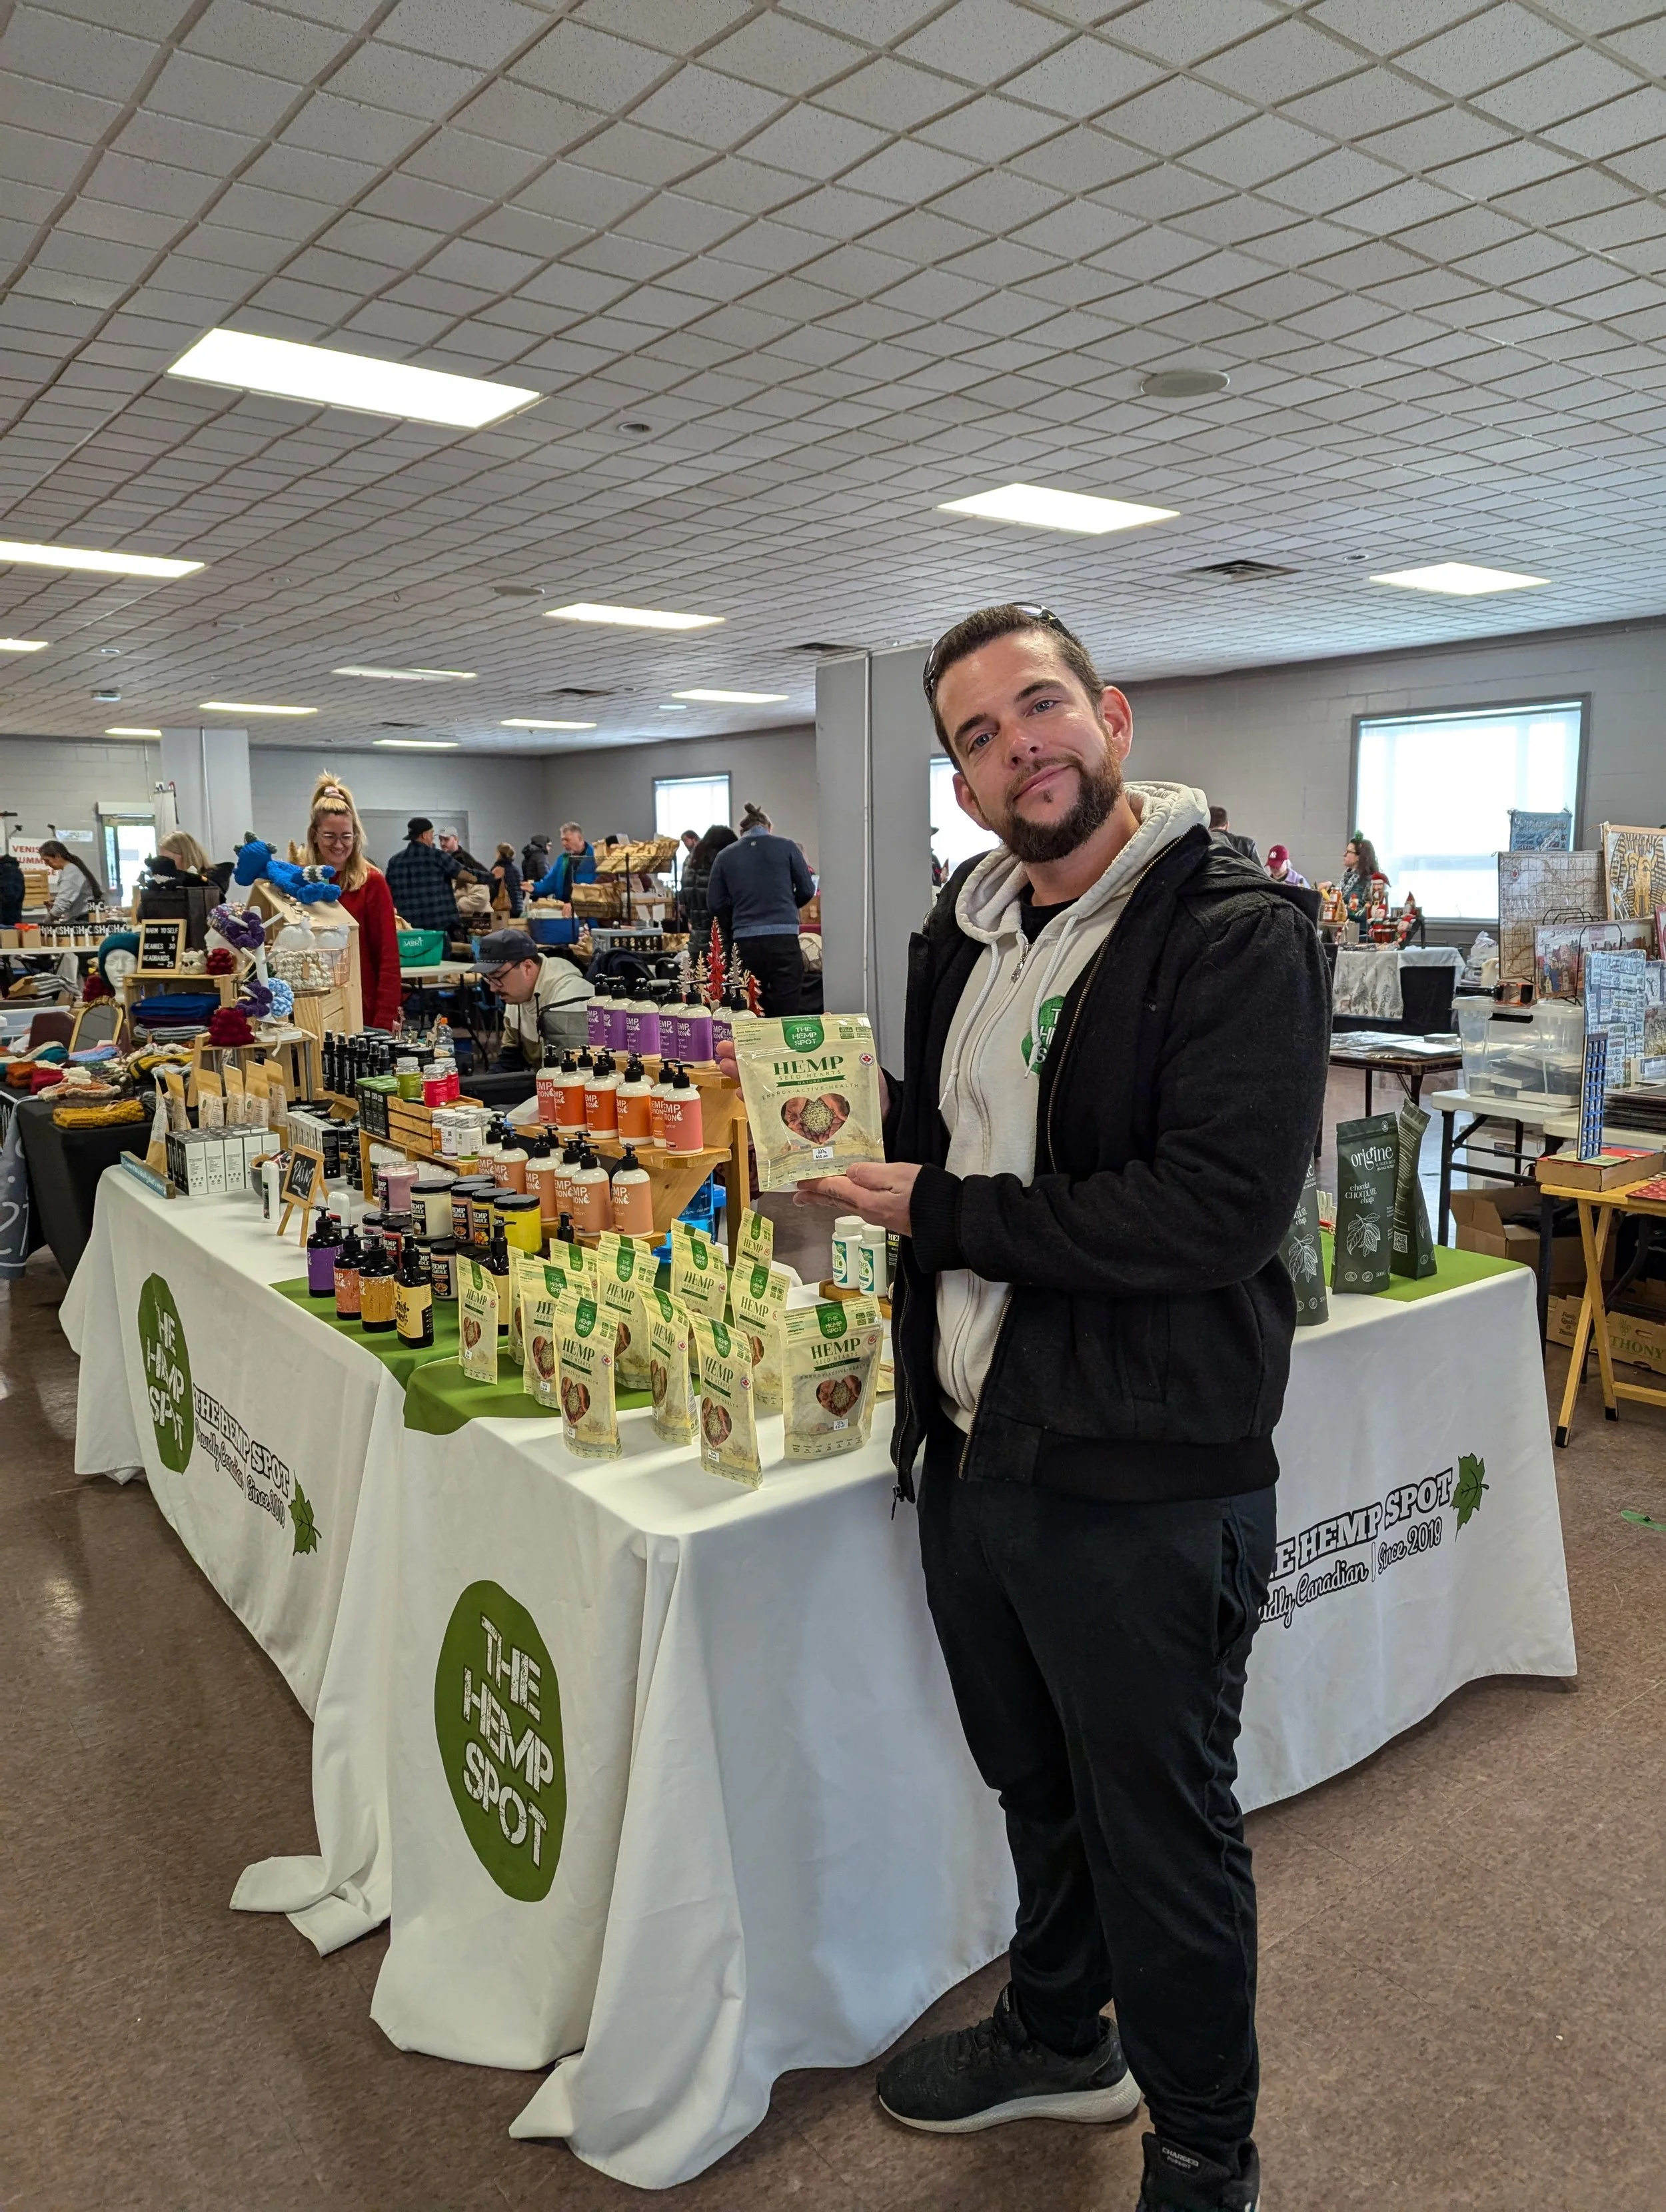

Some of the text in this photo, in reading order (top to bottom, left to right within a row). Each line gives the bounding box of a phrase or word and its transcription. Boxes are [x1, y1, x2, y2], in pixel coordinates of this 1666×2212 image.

[773, 1055, 844, 1075] HEMP
[806, 1069, 842, 1078] HEARTS
[536, 1081, 552, 1090] EMP
[664, 1103, 680, 1113] EMP
[664, 1113, 677, 1121] TION
[478, 1159, 493, 1168] EMP
[1351, 1146, 1394, 1171] origine
[554, 1180, 572, 1191] EMP
[572, 1186, 588, 1196] EMP
[1345, 1187, 1377, 1199] CHOCOLATE
[1349, 1181, 1370, 1191] chocolat
[743, 1238, 763, 1253] HEMP
[684, 1271, 714, 1290] HEMP
[466, 1289, 487, 1305] HEMP
[606, 1283, 634, 1303] HEMP
[536, 1301, 555, 1316] HE
[740, 1296, 769, 1317] HEMP
[155, 1298, 177, 1357] HE
[579, 1317, 592, 1326] HEMP
[654, 1322, 675, 1346] HEMP
[562, 1337, 595, 1362] HEMP
[810, 1338, 861, 1360] HEMP
[834, 1352, 858, 1361] HEARTS
[1610, 1336, 1664, 1359] THONY
[574, 1358, 591, 1369] HEARTS
[706, 1357, 734, 1384] HEMP
[193, 1382, 289, 1499] THE HEMP SPOT
[247, 1474, 271, 1511] Since
[1298, 1502, 1383, 1570] HEMP
[1385, 1467, 1453, 1531] SPOT
[1258, 1516, 1443, 1629] udly Canadian Since 2018
[480, 1614, 541, 1722] THE
[462, 1667, 554, 1794] HEMP
[463, 1742, 547, 1867] SPOT
